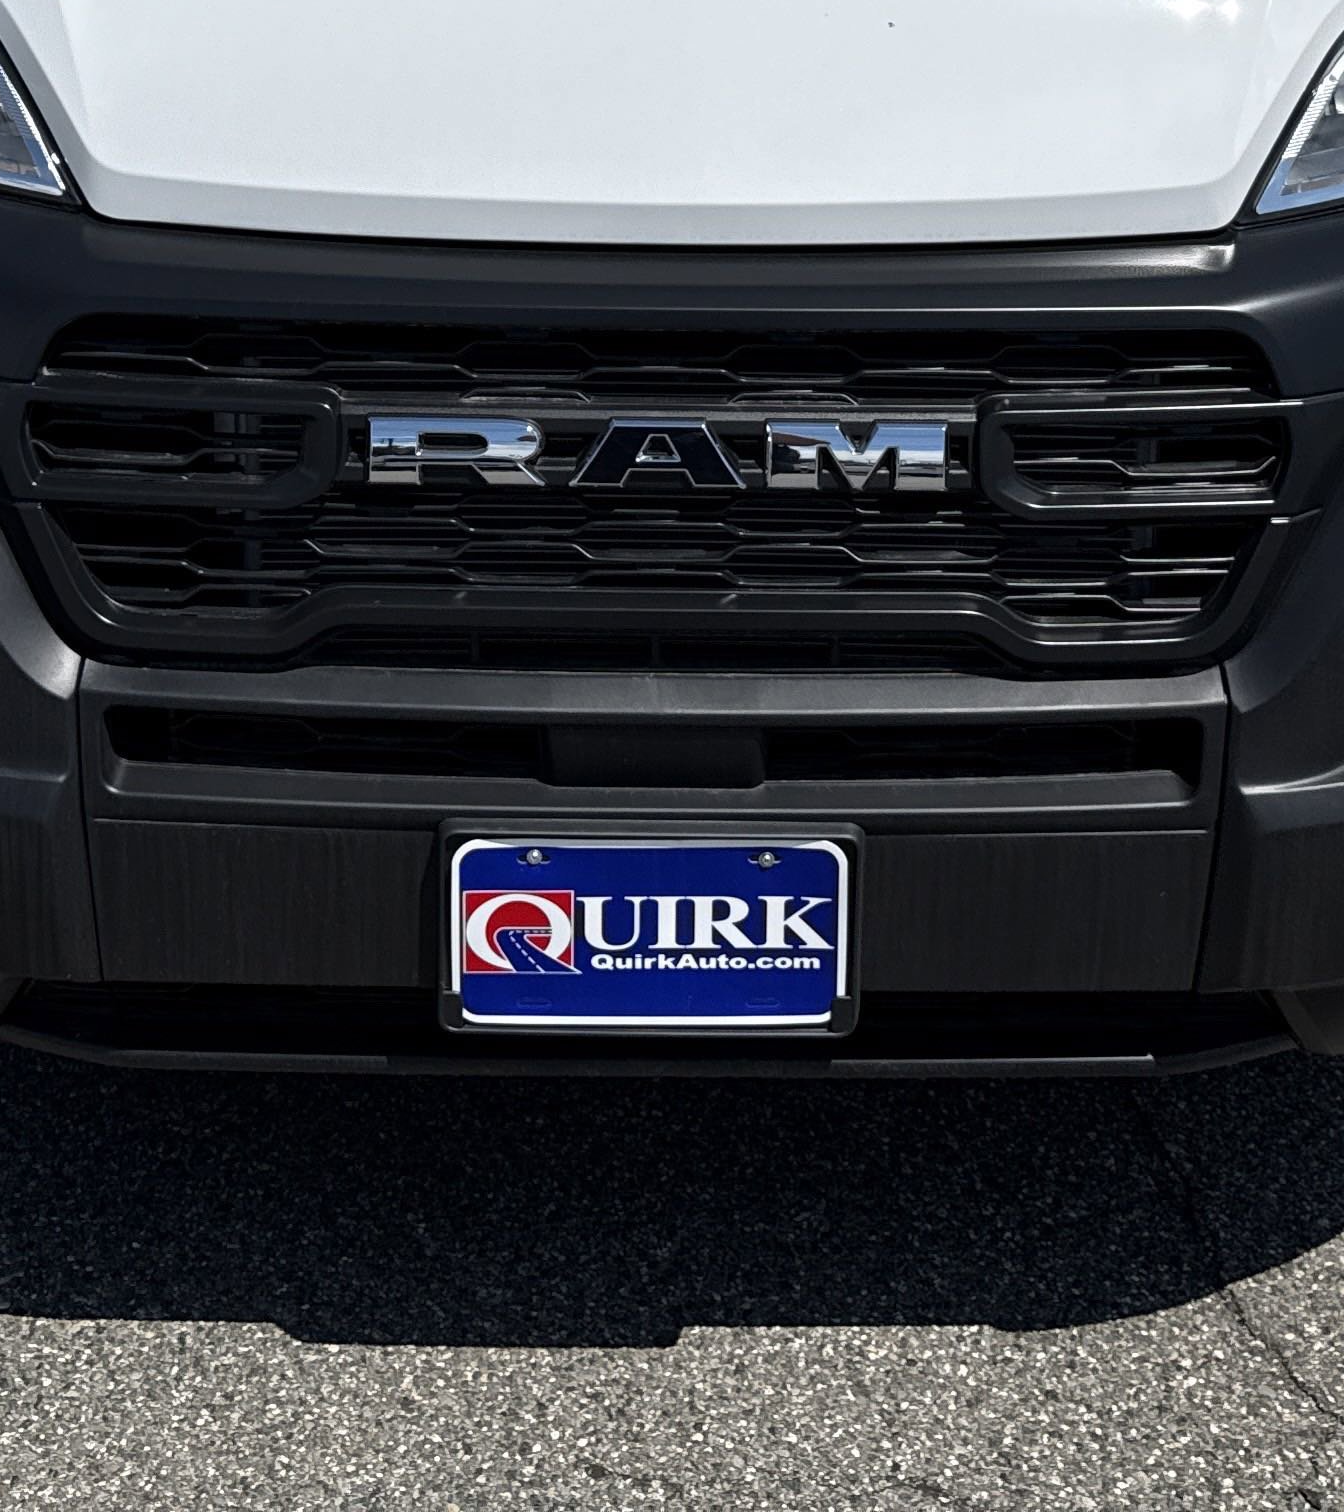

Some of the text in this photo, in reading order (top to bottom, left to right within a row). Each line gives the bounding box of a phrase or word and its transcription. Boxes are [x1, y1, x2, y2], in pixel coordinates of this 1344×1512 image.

[368, 415, 949, 490] RAM
[465, 892, 836, 974] QUIRK
[590, 952, 822, 971] QuirkAuto.com
